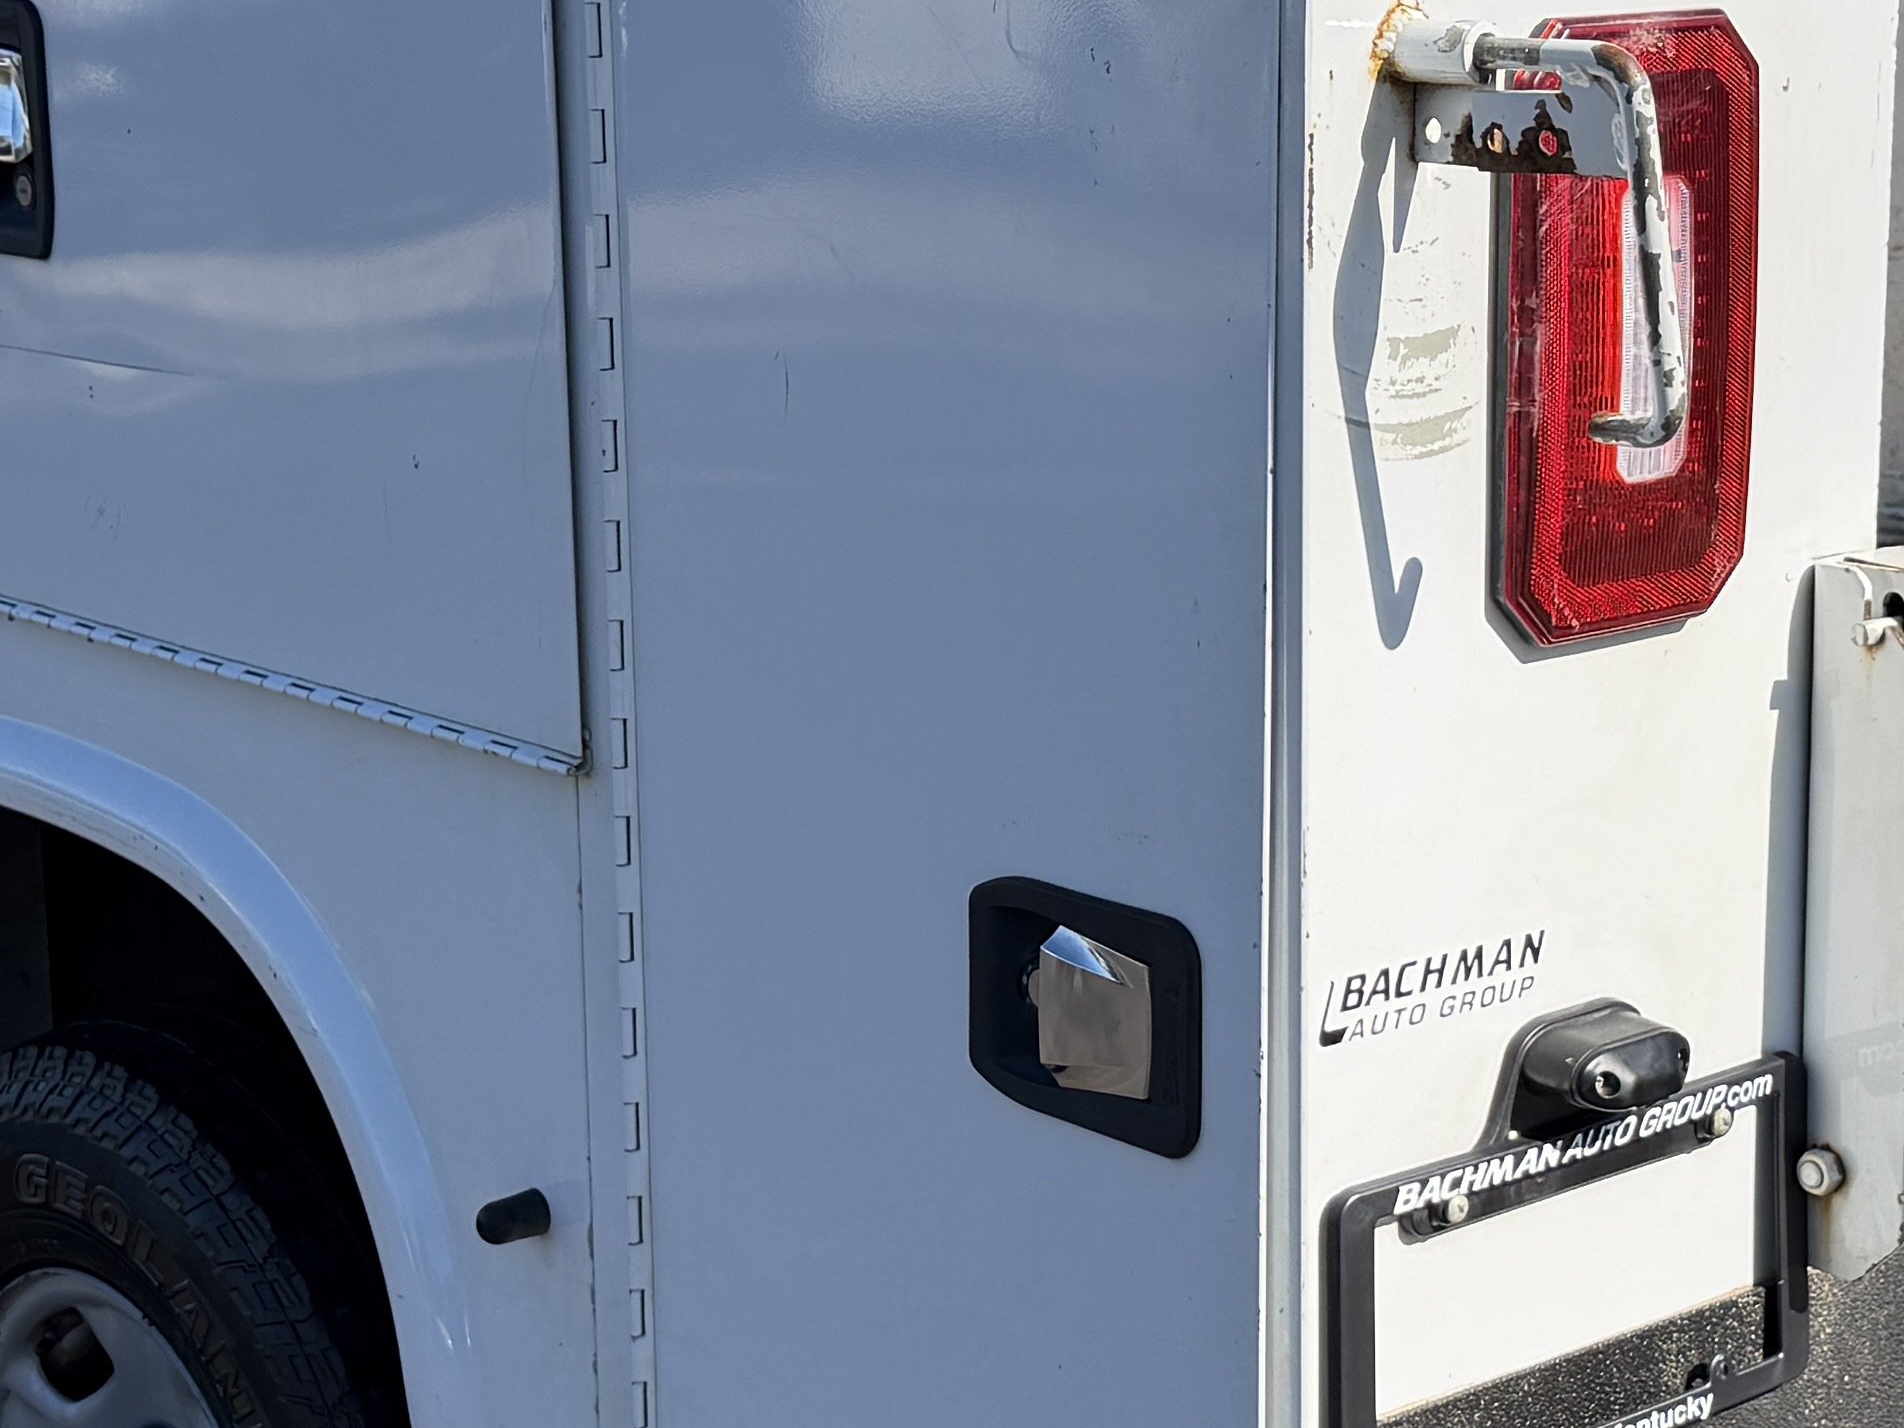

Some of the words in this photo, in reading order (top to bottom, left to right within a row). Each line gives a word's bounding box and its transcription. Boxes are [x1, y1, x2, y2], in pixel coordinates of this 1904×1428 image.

[1340, 929, 1545, 1013] BACHMAN
[1349, 1003, 1426, 1042] AUTO
[1439, 976, 1535, 1018] GROUP
[1393, 1140, 1562, 1215] BACHMAN
[1561, 1115, 1638, 1164] AUTO
[1639, 1073, 1773, 1137] GROUP.com
